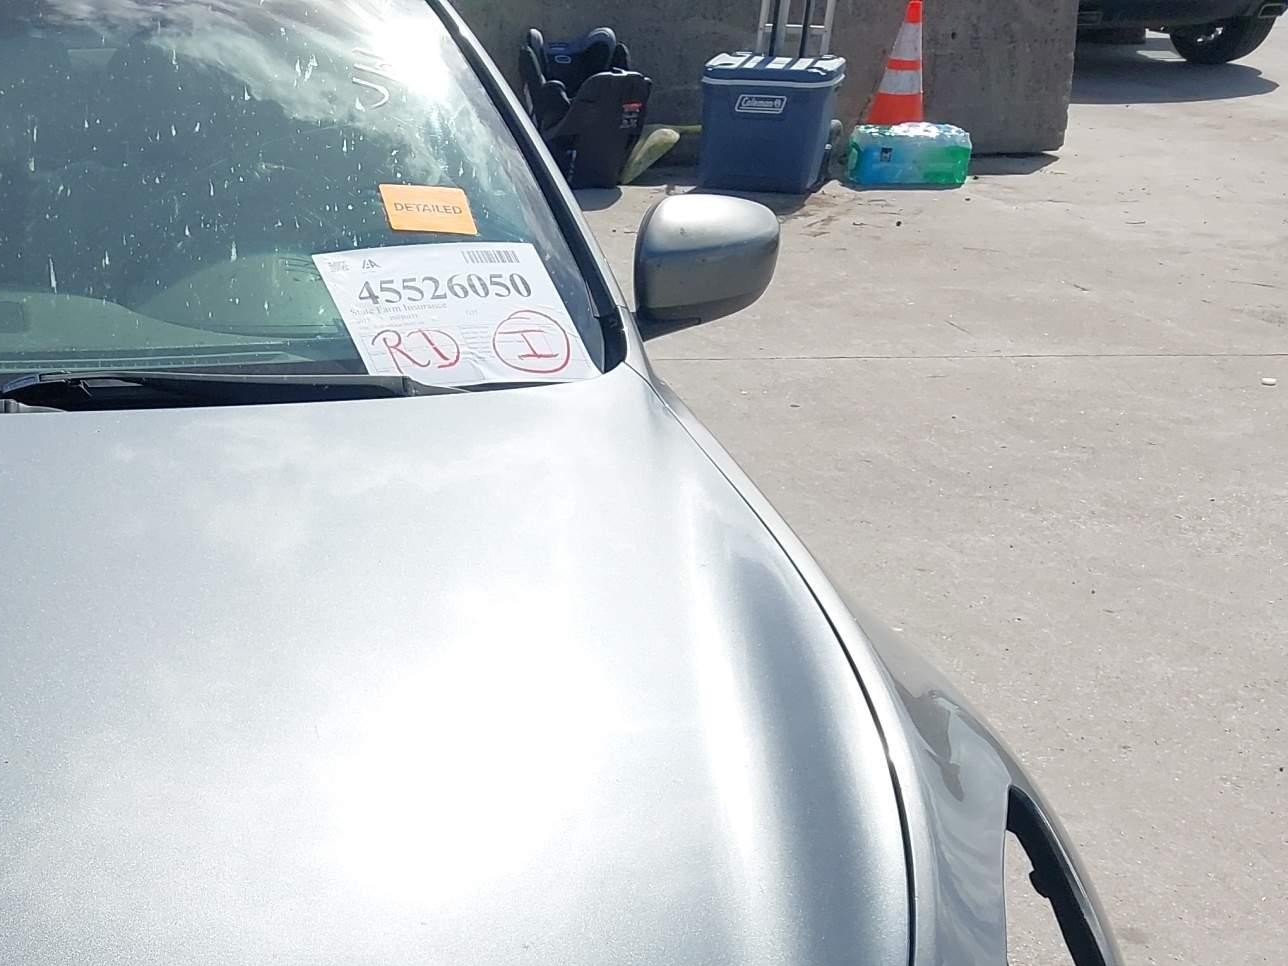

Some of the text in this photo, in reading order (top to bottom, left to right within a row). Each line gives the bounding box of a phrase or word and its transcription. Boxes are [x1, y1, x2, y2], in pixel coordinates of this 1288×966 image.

[393, 202, 463, 215] DETAILED
[358, 273, 532, 305] 45526050
[376, 303, 402, 315] Farm
